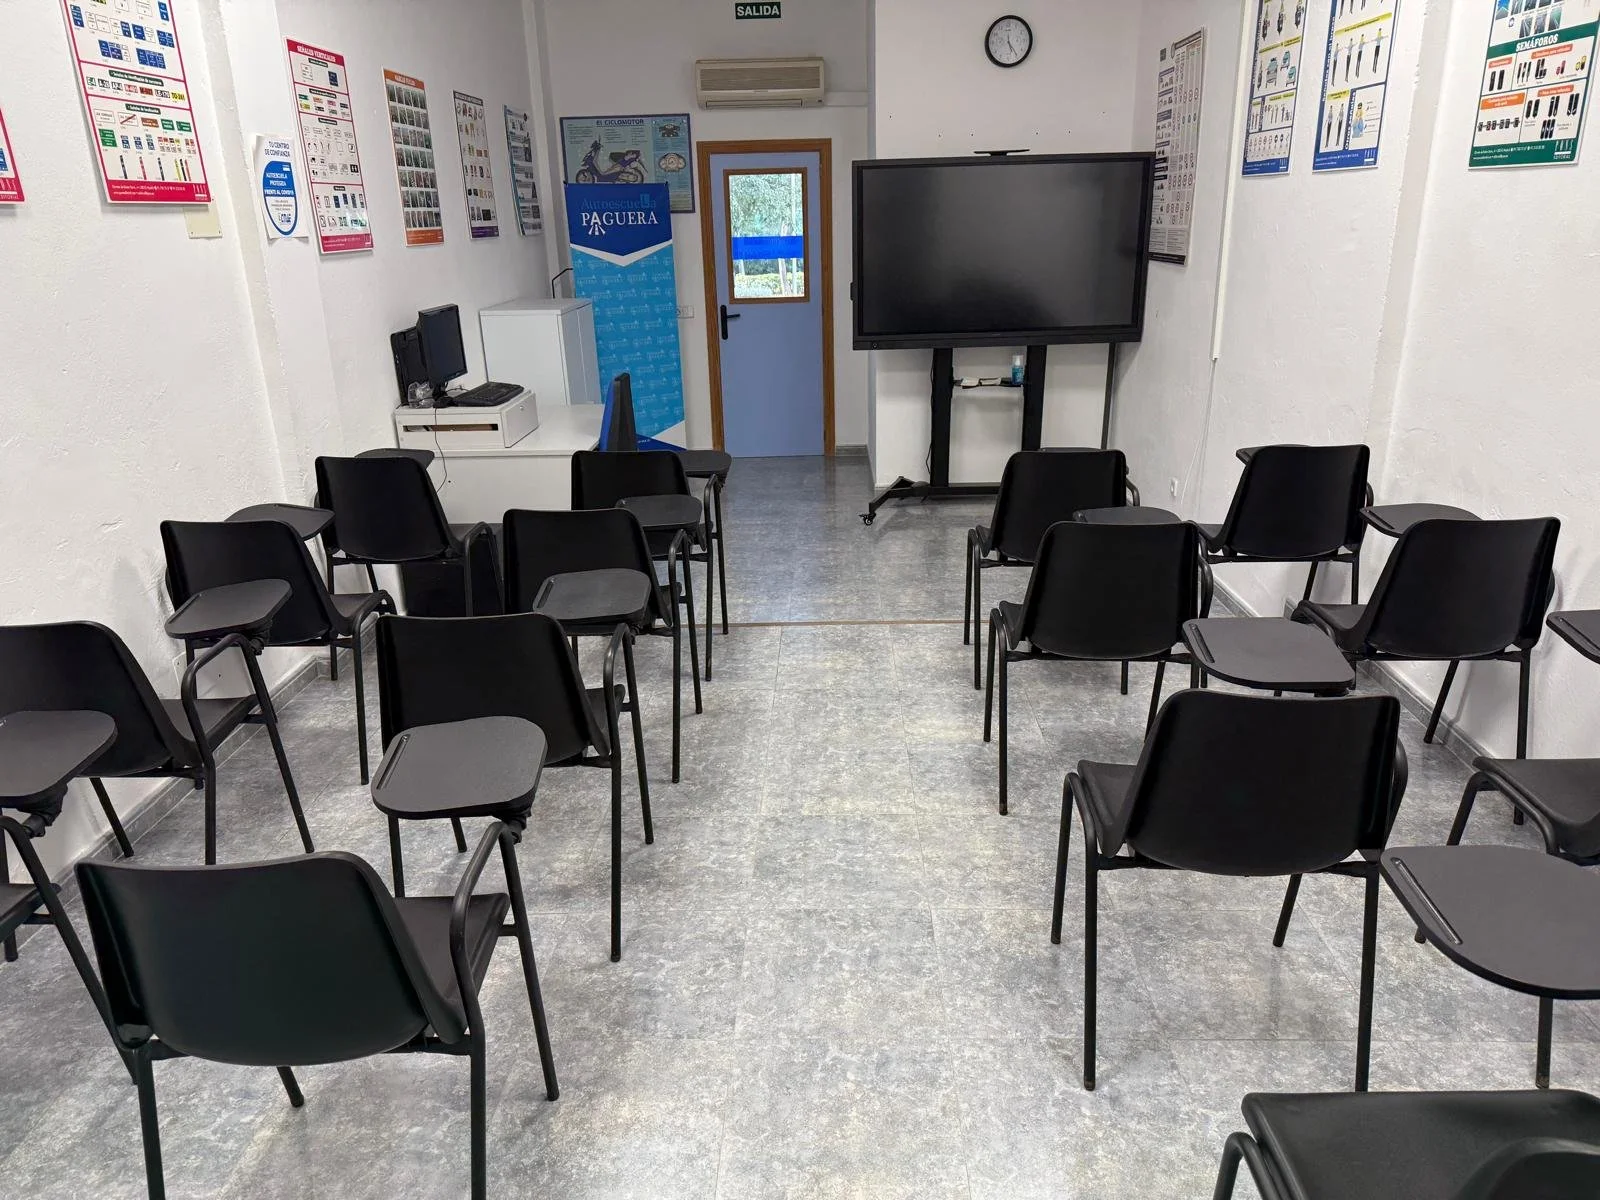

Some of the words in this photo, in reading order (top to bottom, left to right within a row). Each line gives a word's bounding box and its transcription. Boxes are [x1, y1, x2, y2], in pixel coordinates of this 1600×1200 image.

[737, 5, 780, 16] SALIDA
[1516, 33, 1559, 52] SEMÁFOROS
[581, 211, 659, 227] PAGUERA
